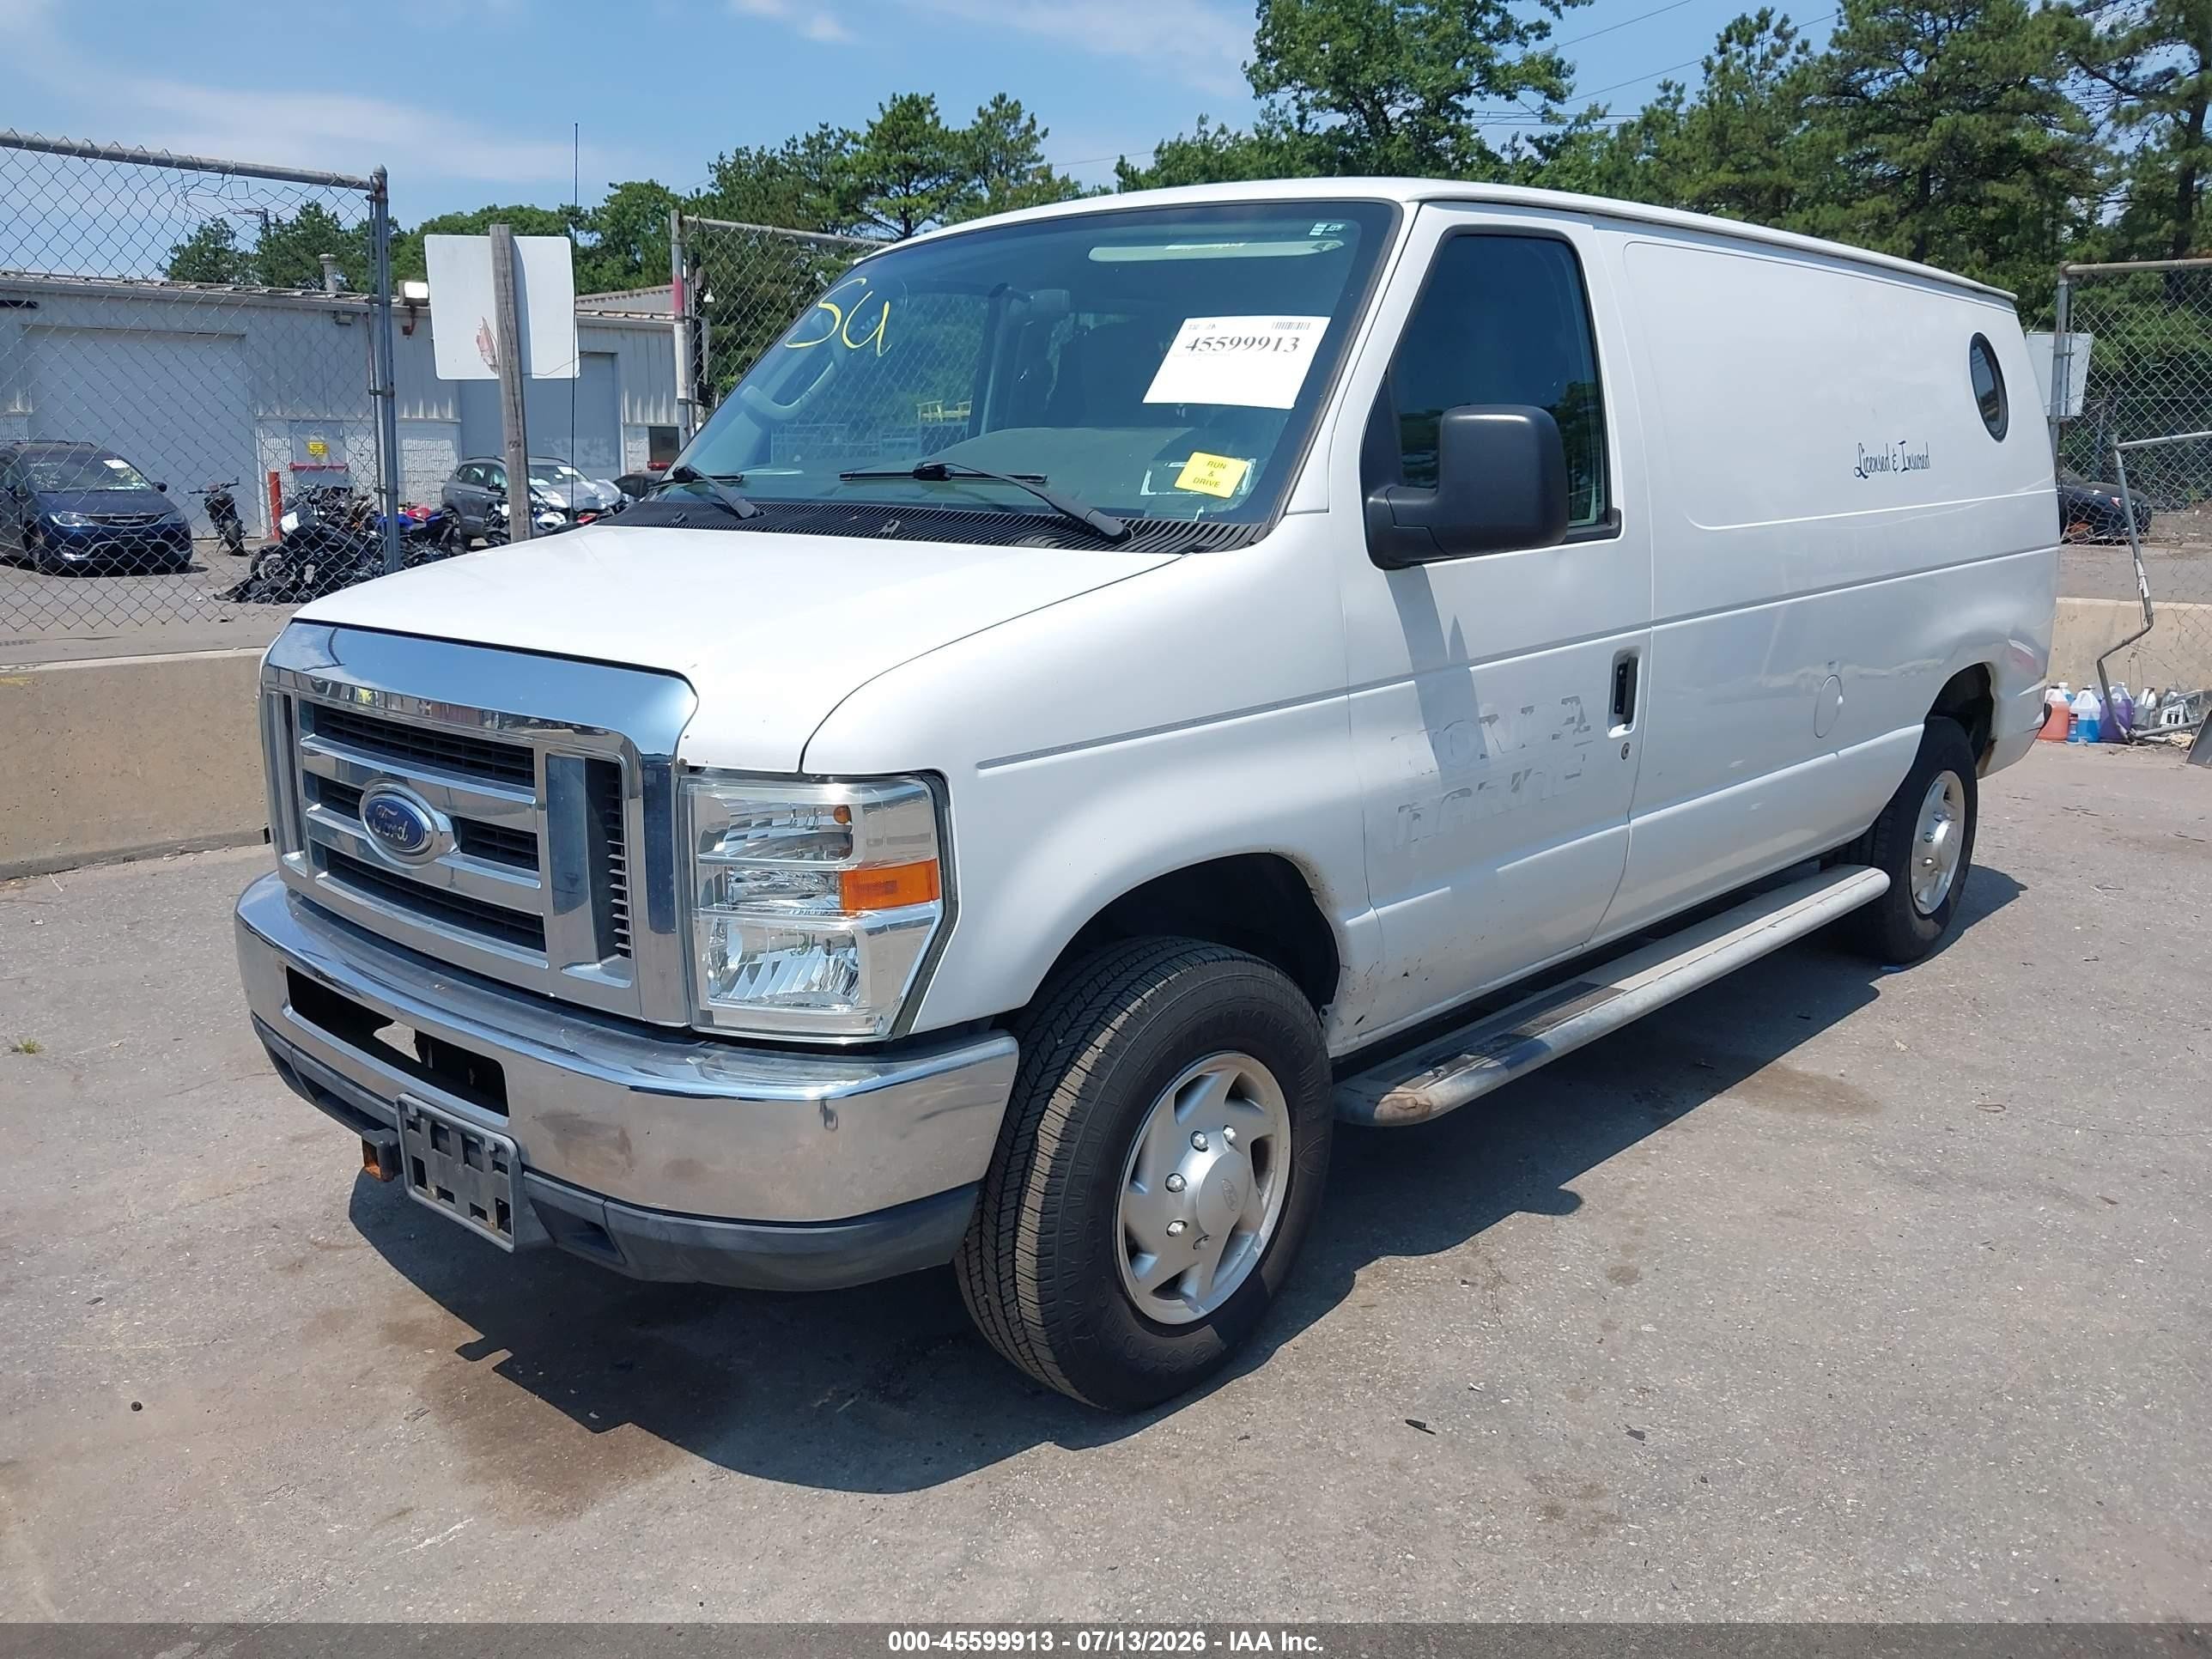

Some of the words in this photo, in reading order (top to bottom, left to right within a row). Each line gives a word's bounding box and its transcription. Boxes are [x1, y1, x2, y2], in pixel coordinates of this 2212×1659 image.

[1185, 336, 1300, 353] 45599913
[1206, 460, 1227, 470] RUN
[1854, 442, 1890, 479] Licensed
[1892, 447, 1899, 475] &
[1898, 440, 1930, 473] Insured
[1193, 477, 1221, 489] DRIVE
[373, 805, 409, 842] Ford
